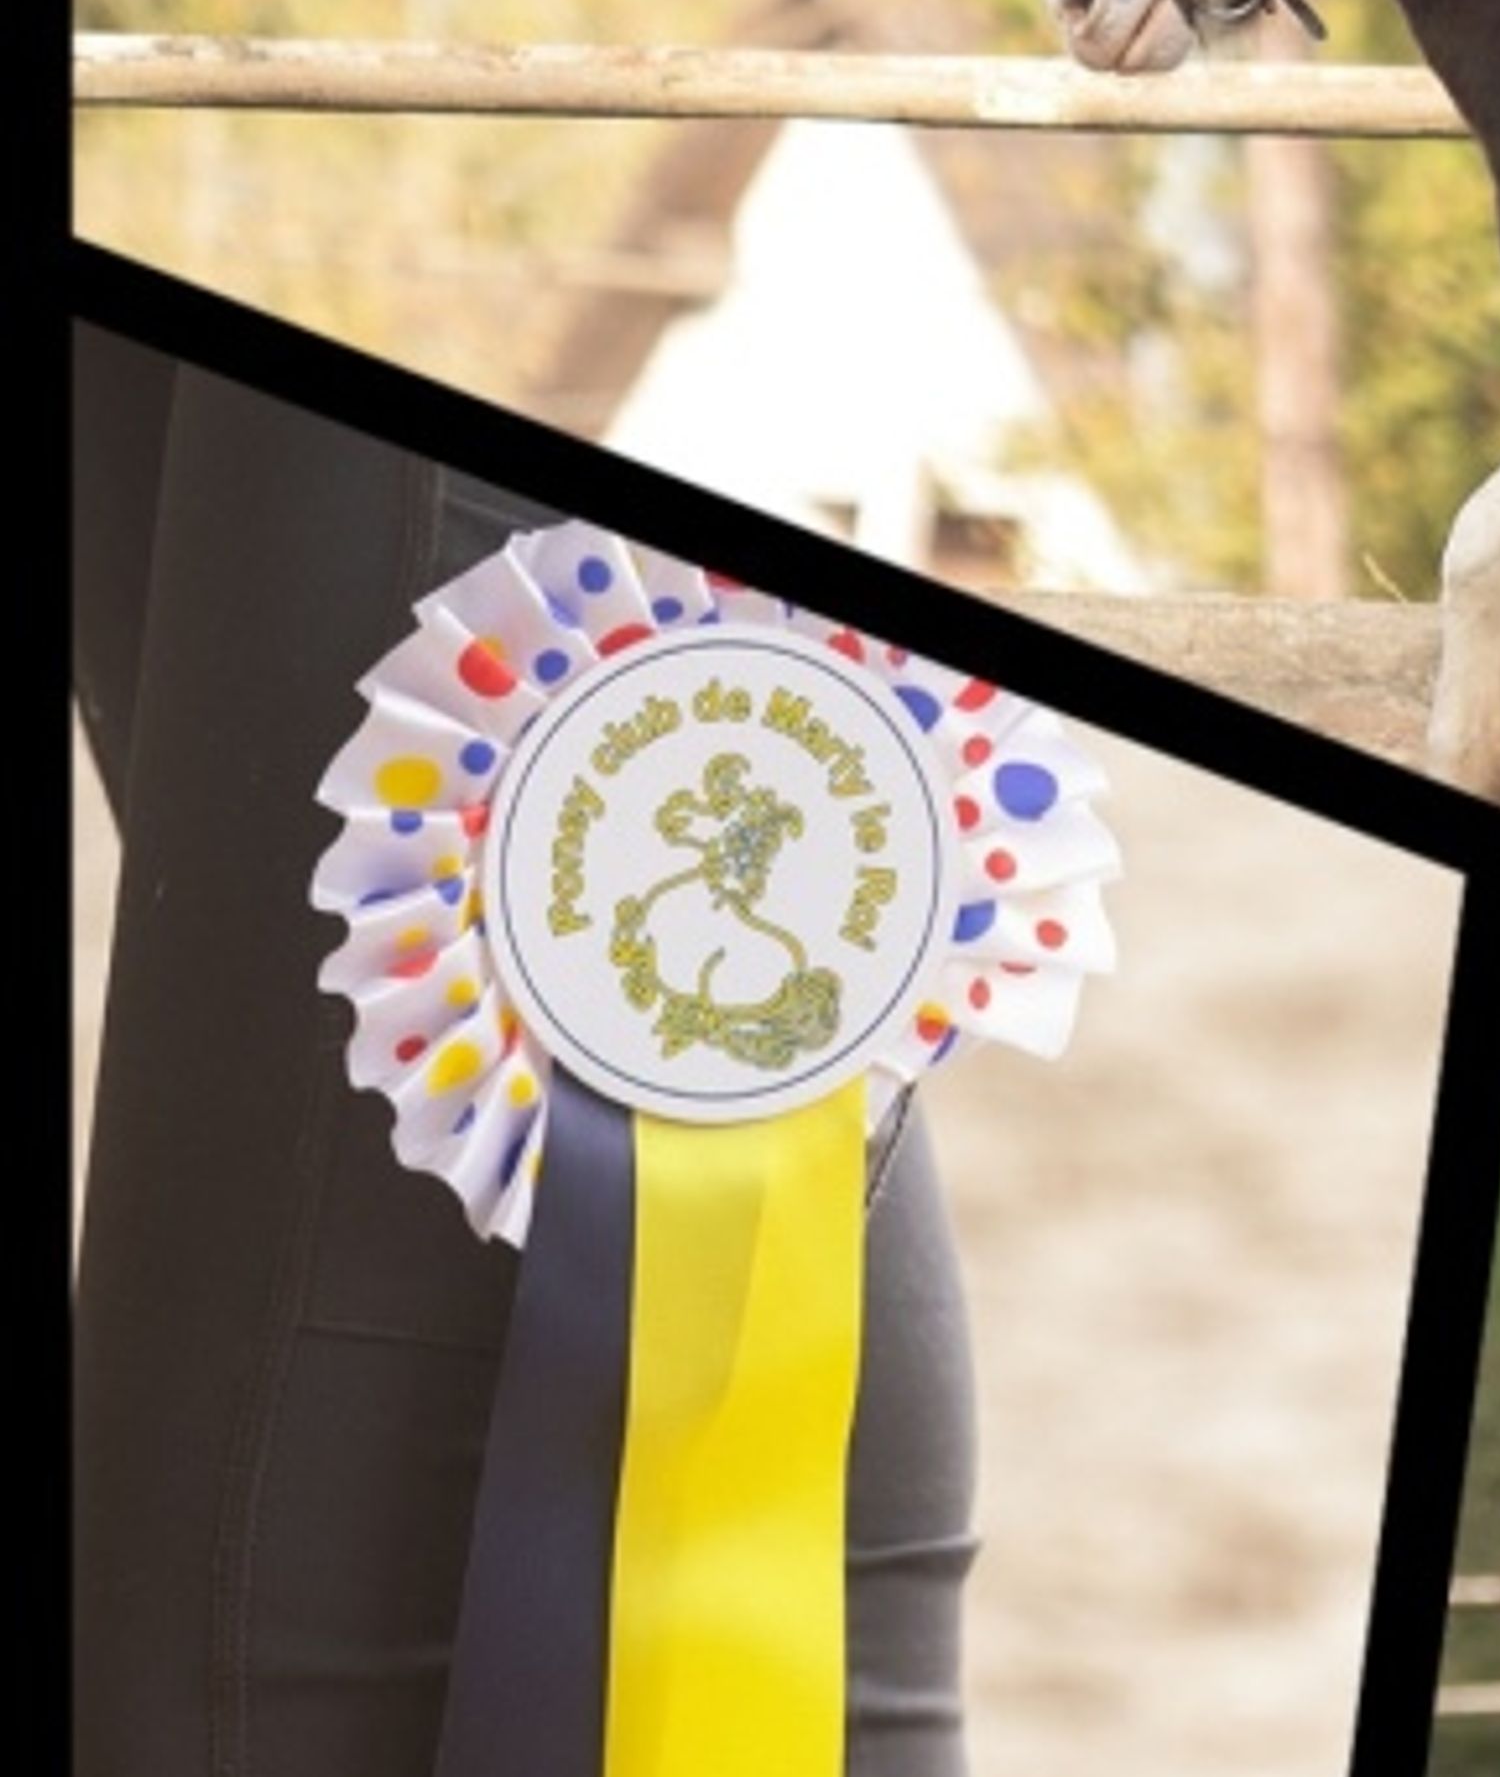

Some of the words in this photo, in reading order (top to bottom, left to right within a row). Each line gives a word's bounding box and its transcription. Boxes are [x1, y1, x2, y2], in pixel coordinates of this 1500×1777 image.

[590, 695, 682, 776] club
[692, 677, 751, 724] de
[547, 773, 606, 937] Poney
[849, 802, 893, 855] le
[837, 865, 898, 952] Roi
